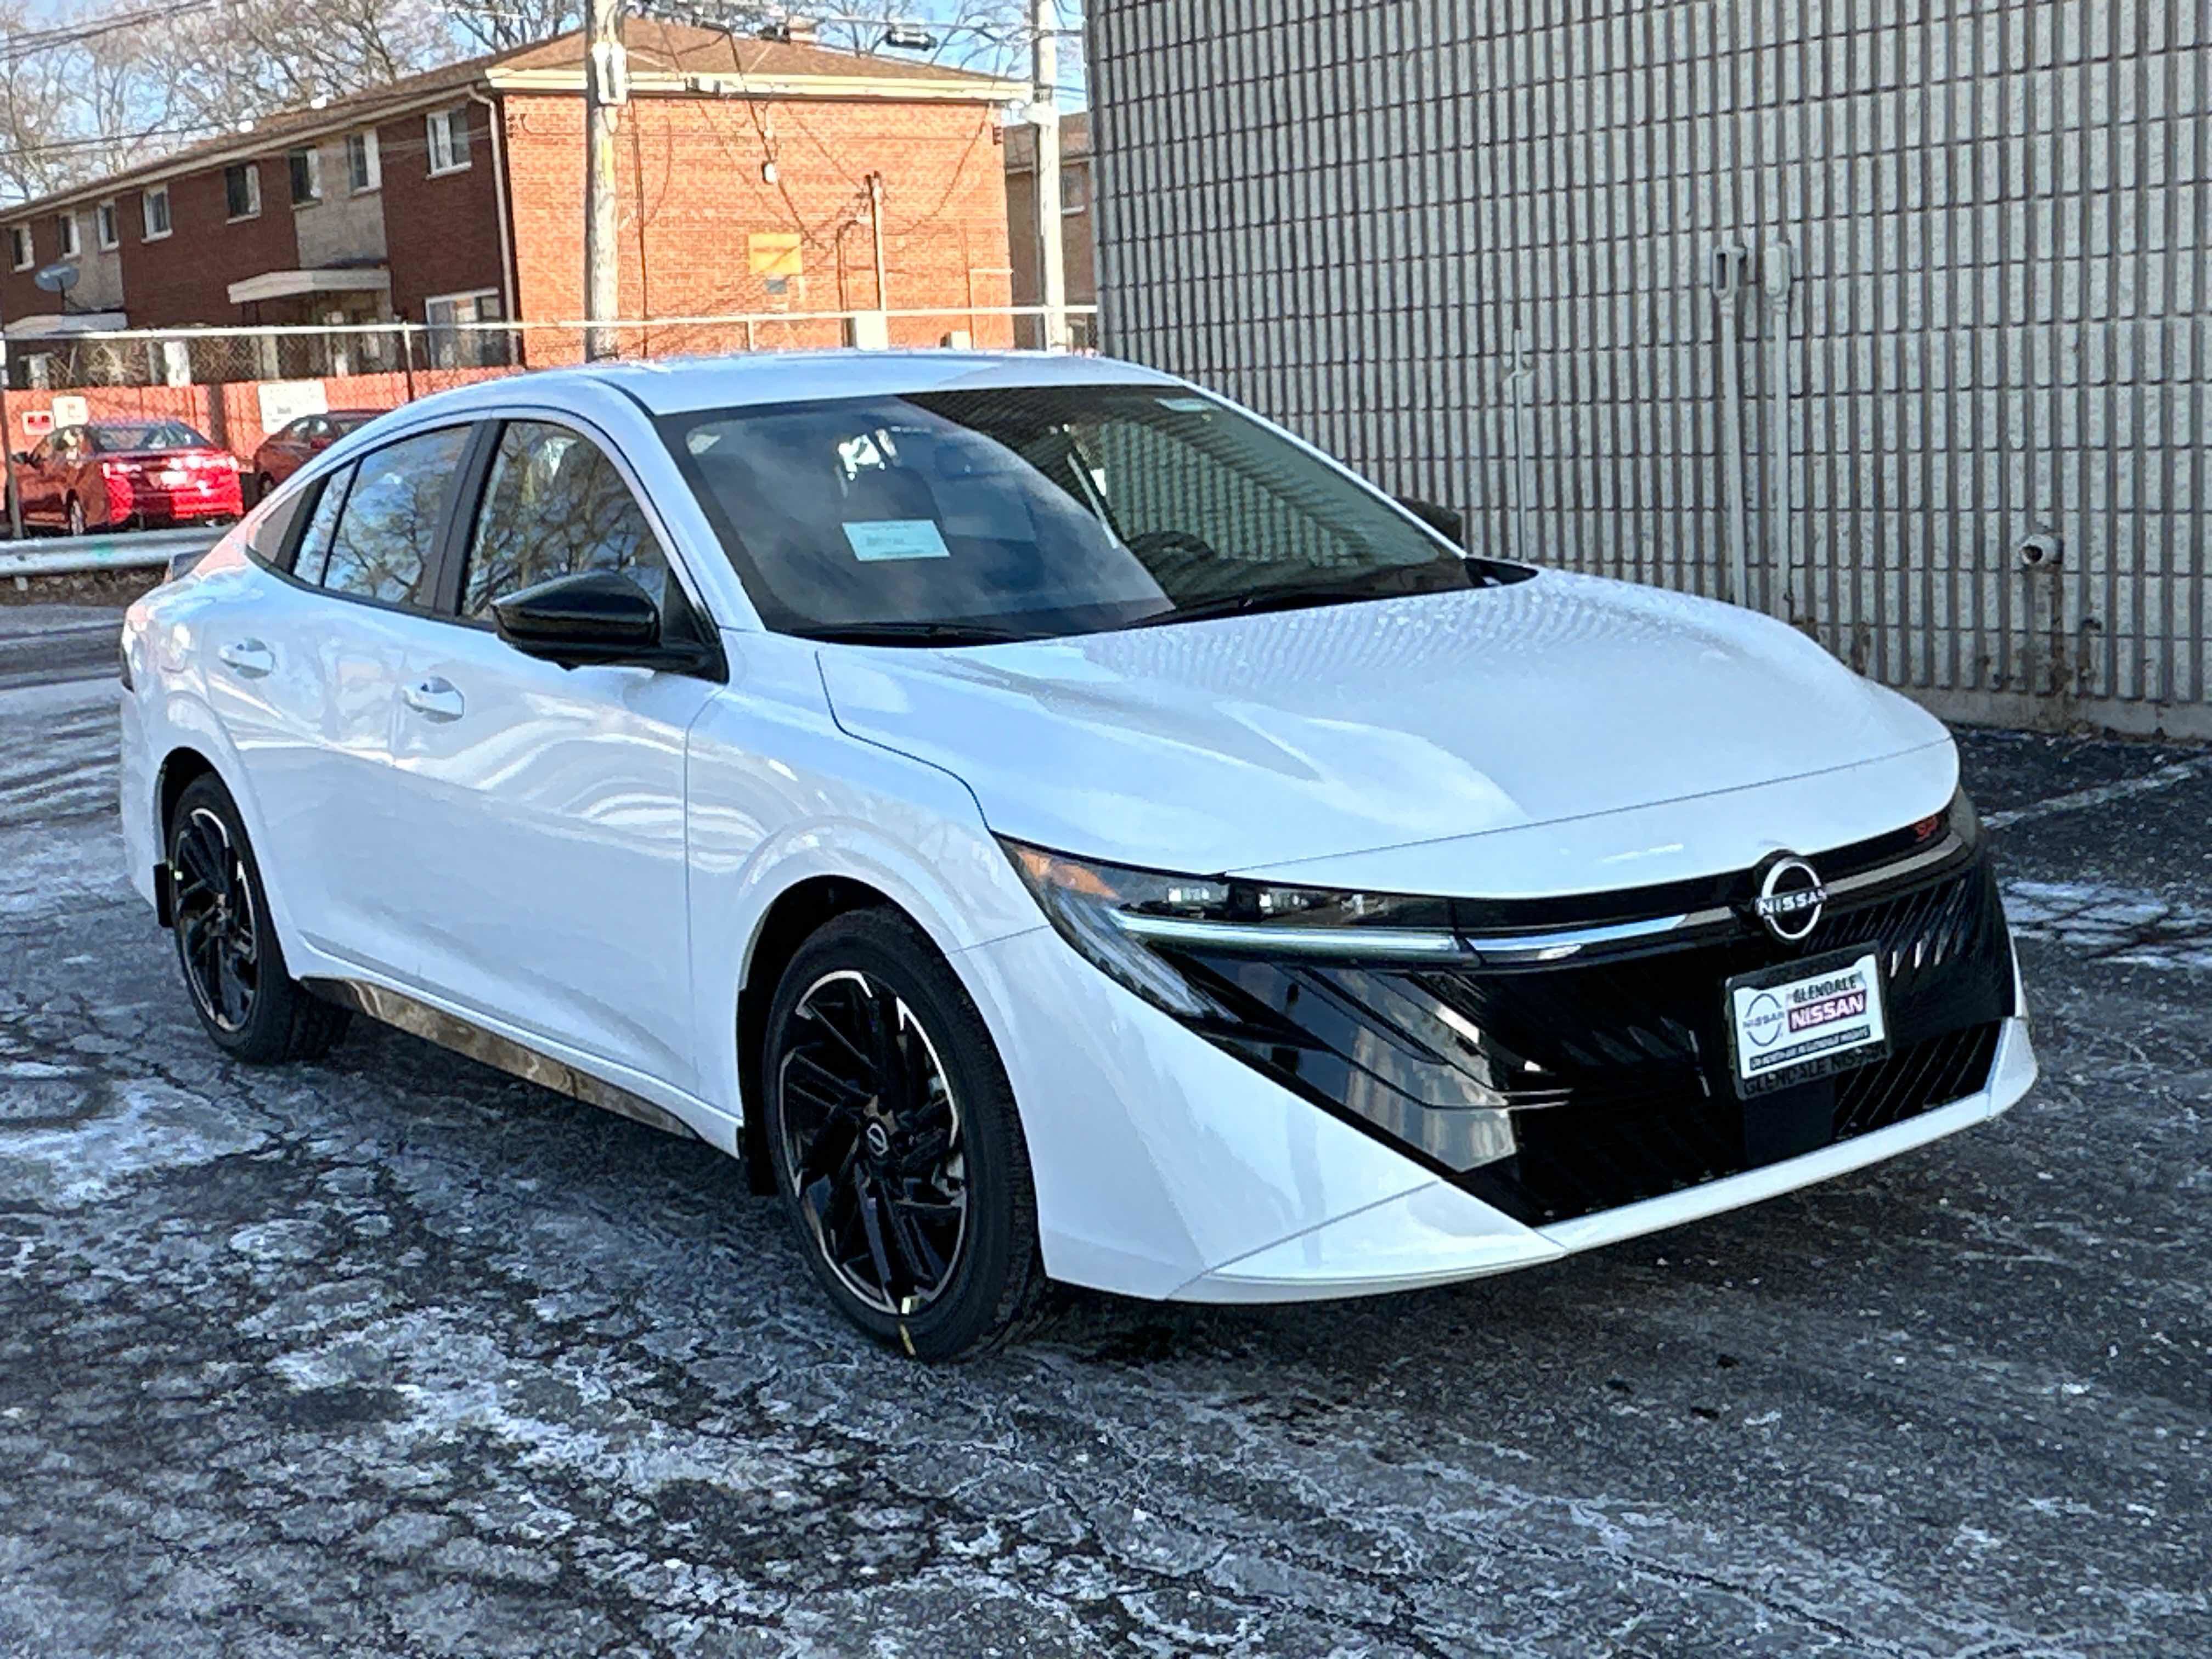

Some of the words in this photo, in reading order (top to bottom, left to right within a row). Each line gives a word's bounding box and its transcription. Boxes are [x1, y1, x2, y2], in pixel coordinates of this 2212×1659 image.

[1756, 888, 1827, 917] NISSAN
[1793, 975, 1857, 1003] GLENDALE
[1743, 1011, 1784, 1028] NISSAN
[1791, 993, 1863, 1029] NISSAN
